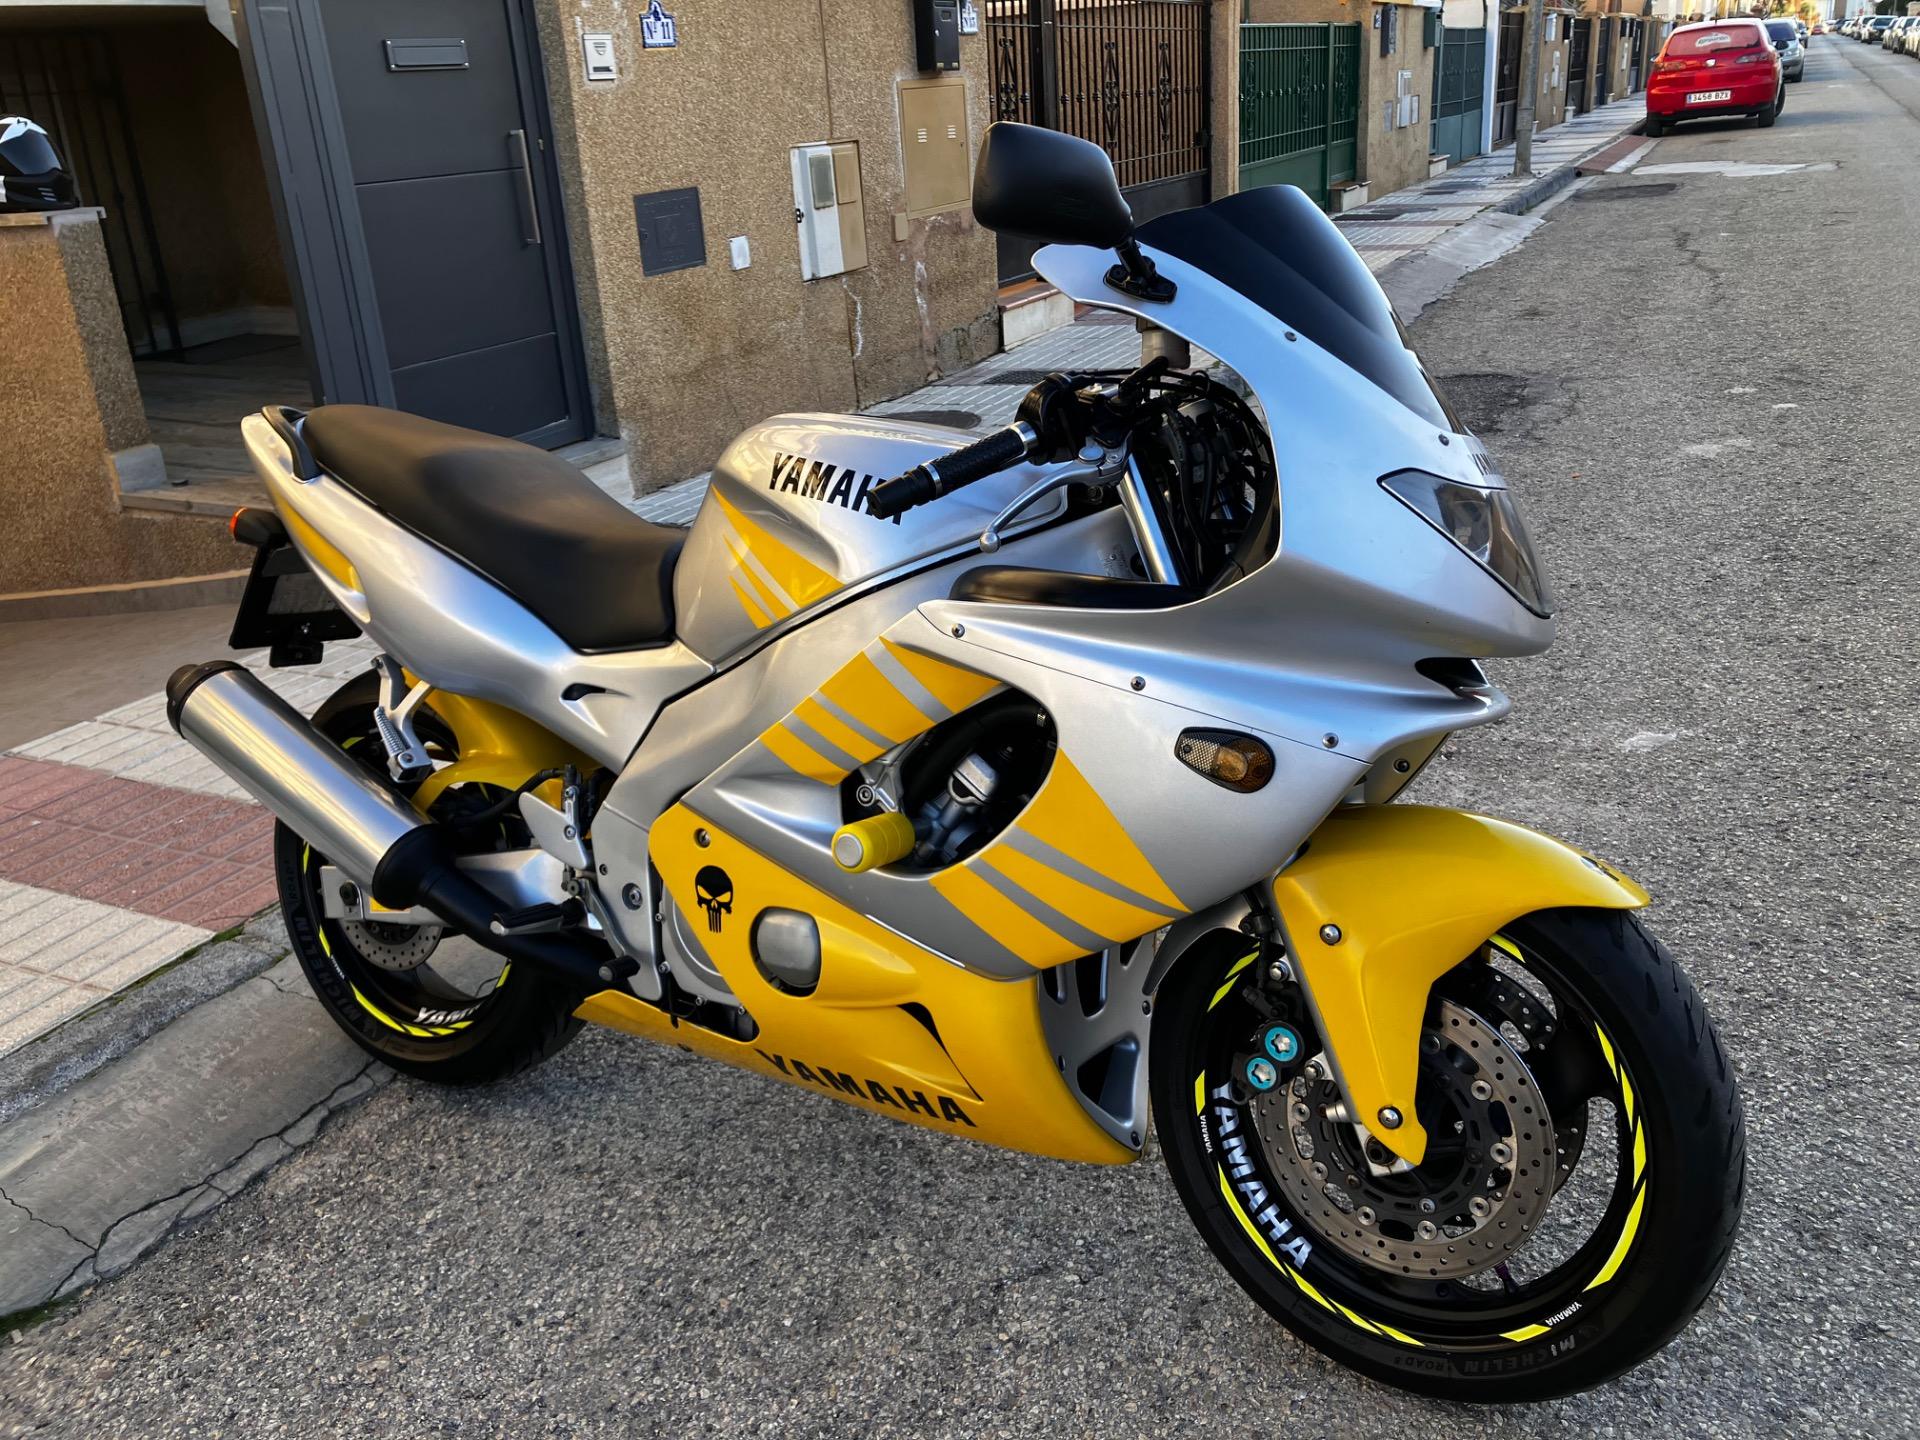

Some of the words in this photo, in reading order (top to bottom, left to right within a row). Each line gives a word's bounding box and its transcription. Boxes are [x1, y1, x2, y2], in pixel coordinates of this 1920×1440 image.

[661, 21, 672, 39] 11
[769, 452, 901, 525] YAMAH
[753, 1048, 977, 1127] YAMAHA
[1200, 1115, 1213, 1154] YAMAHA
[1546, 1302, 1582, 1326] YAMAHA
[1464, 1334, 1576, 1374] MICHELIN
